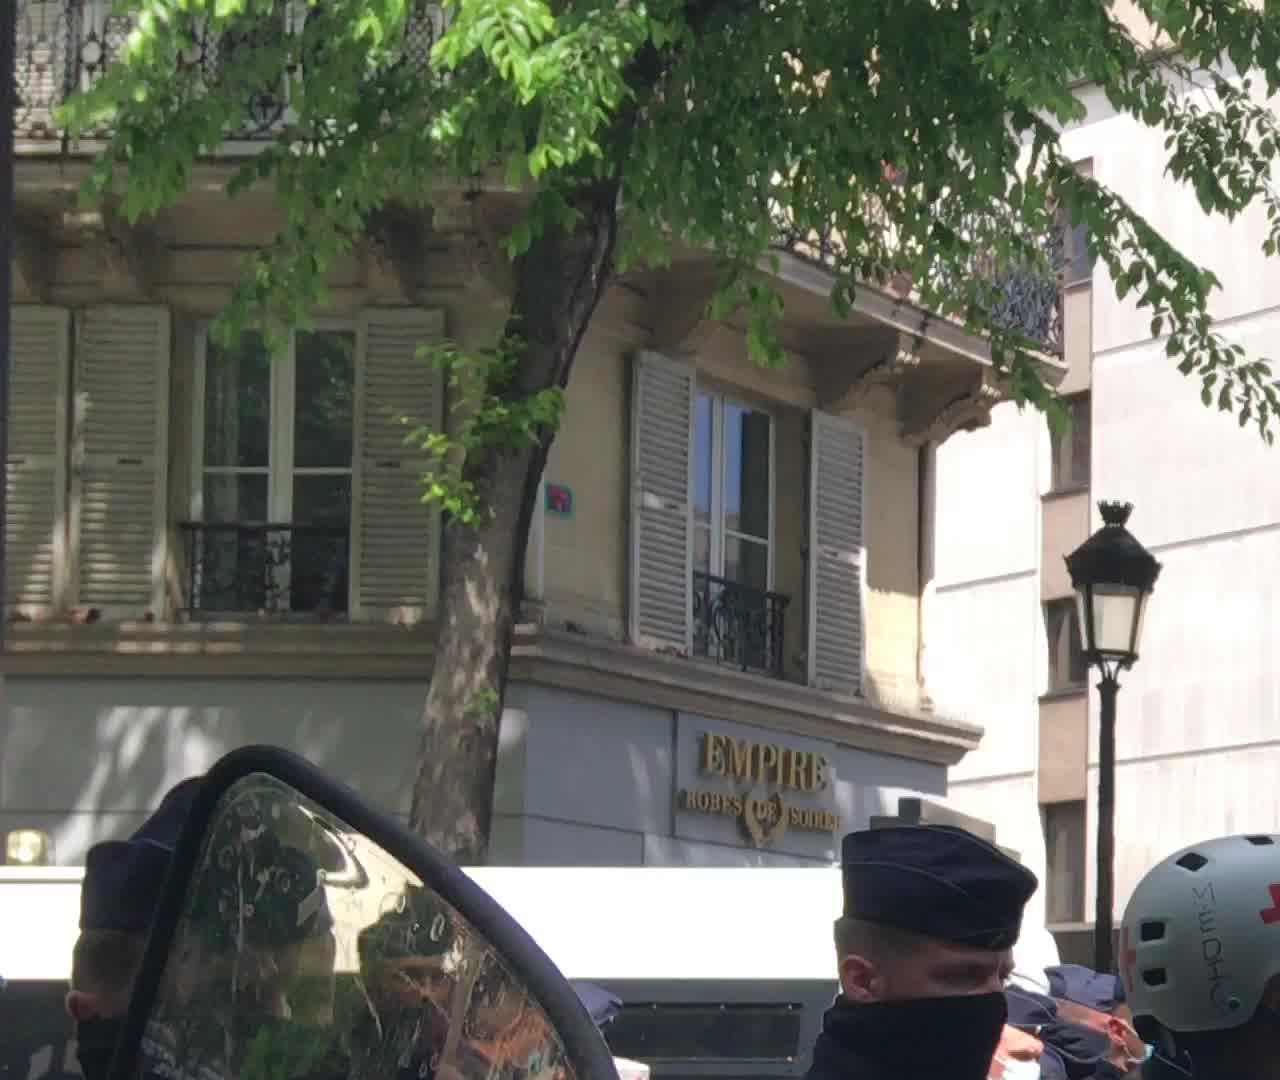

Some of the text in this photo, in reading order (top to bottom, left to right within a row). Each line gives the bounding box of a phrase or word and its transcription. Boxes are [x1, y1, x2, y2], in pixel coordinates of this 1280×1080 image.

[701, 731, 829, 793] EMPIRE
[685, 790, 744, 817] ROBES
[754, 799, 777, 820] DE
